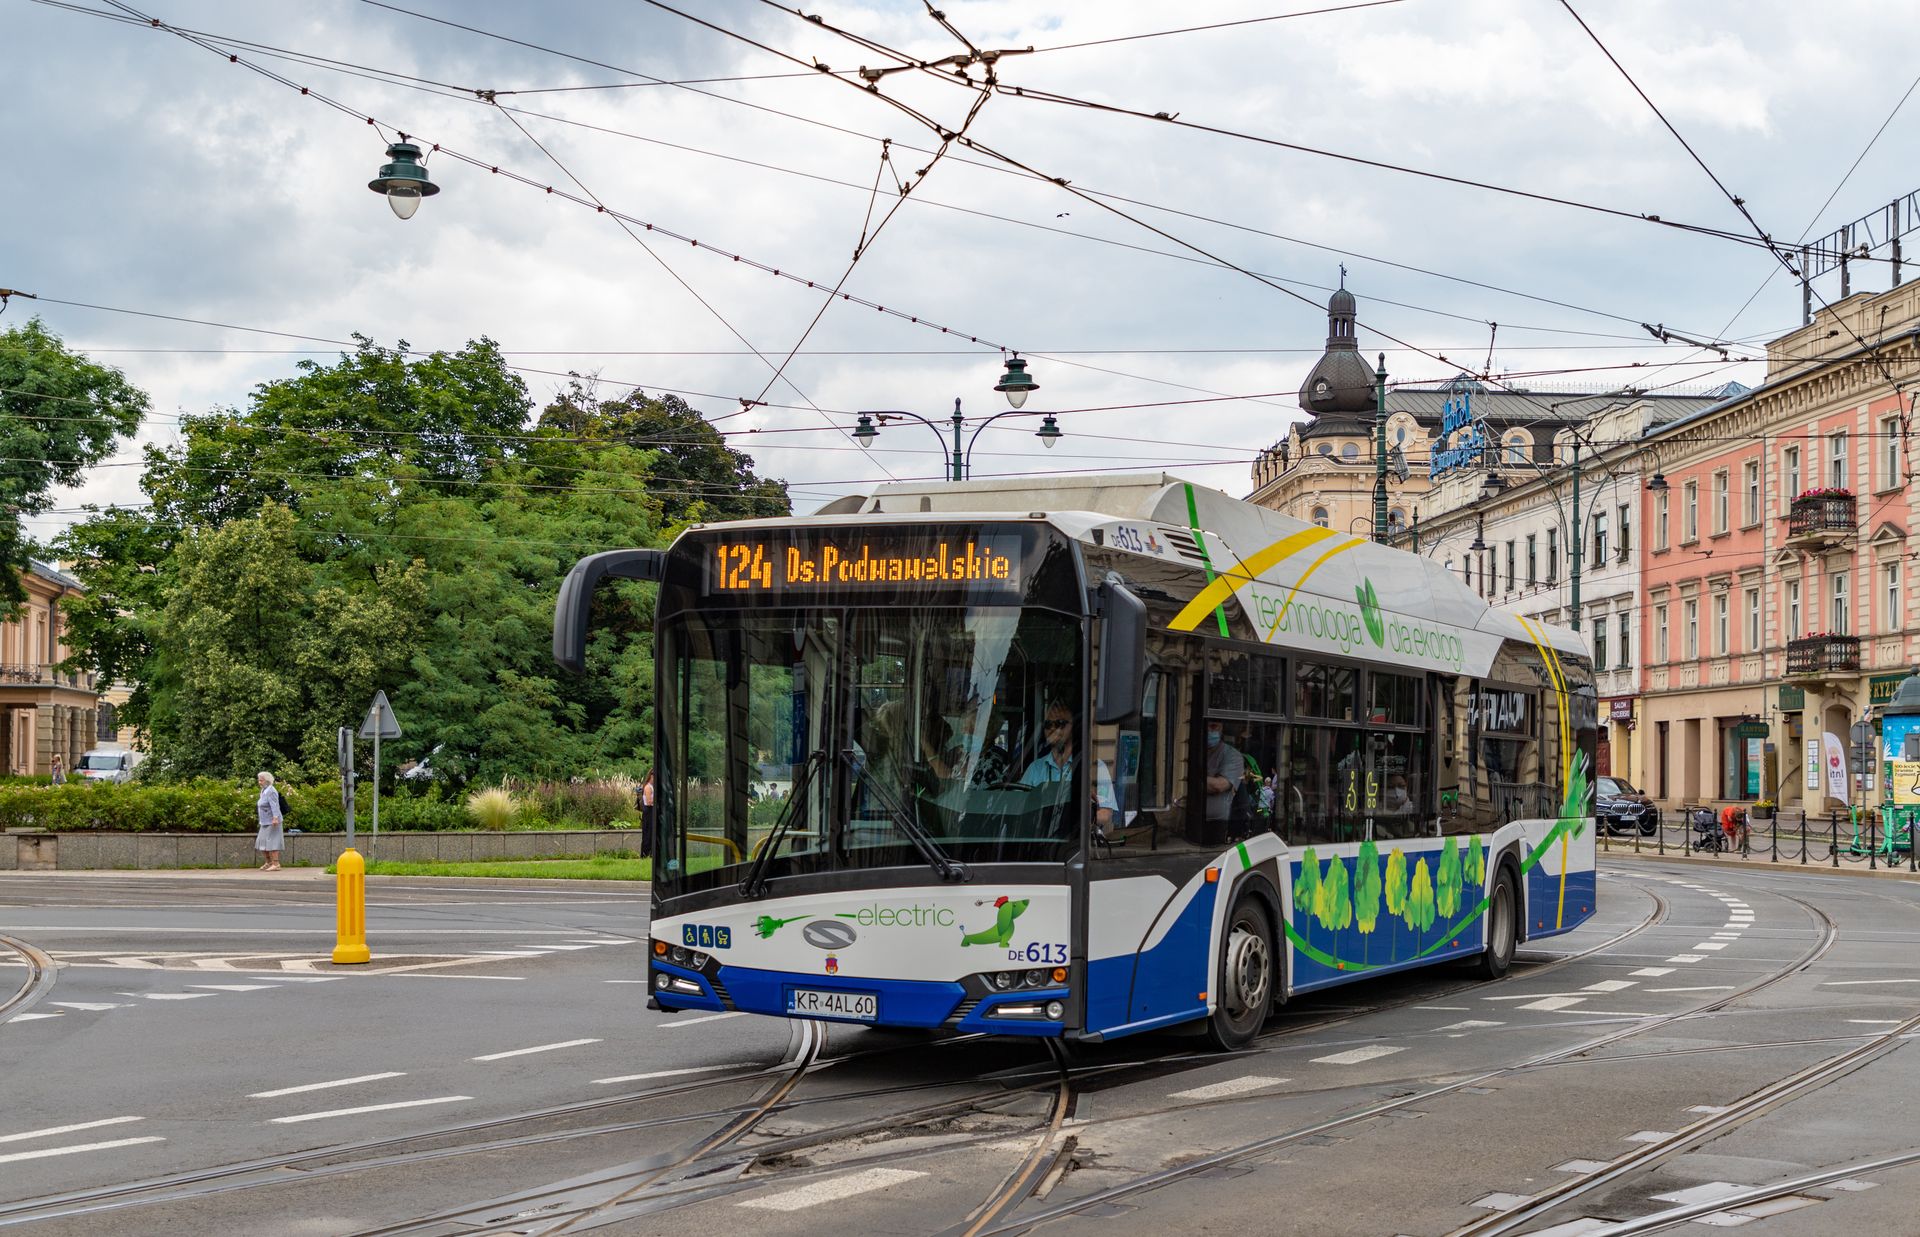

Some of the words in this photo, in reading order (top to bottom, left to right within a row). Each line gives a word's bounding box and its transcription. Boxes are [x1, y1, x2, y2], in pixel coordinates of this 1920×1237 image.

[718, 544, 772, 589] 124
[1251, 584, 1364, 654] technologia
[857, 903, 955, 927] electric
[797, 992, 819, 1011] KR
[825, 994, 874, 1014] 4AL60
